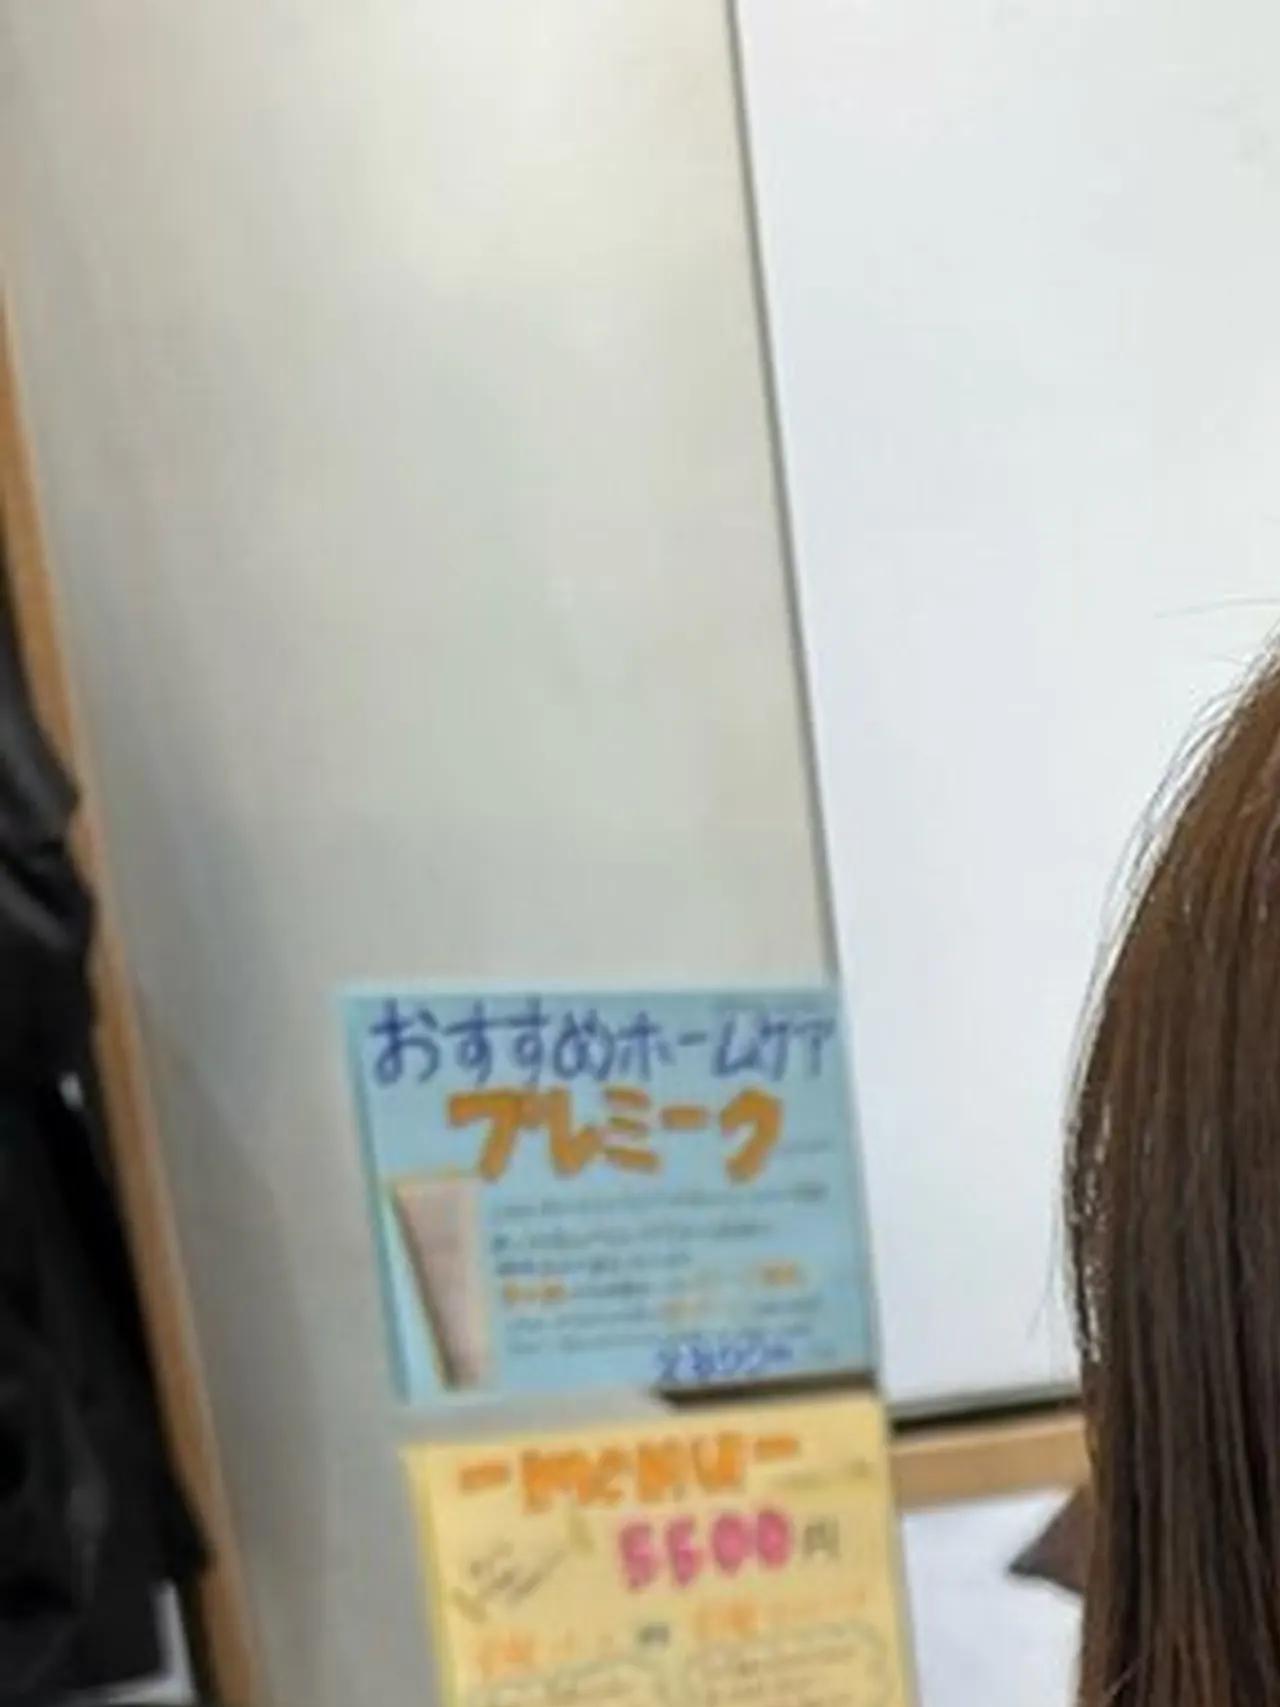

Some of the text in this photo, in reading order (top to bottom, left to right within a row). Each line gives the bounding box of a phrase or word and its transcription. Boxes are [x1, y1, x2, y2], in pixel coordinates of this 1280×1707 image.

[370, 994, 836, 1085] おすすめホームケア
